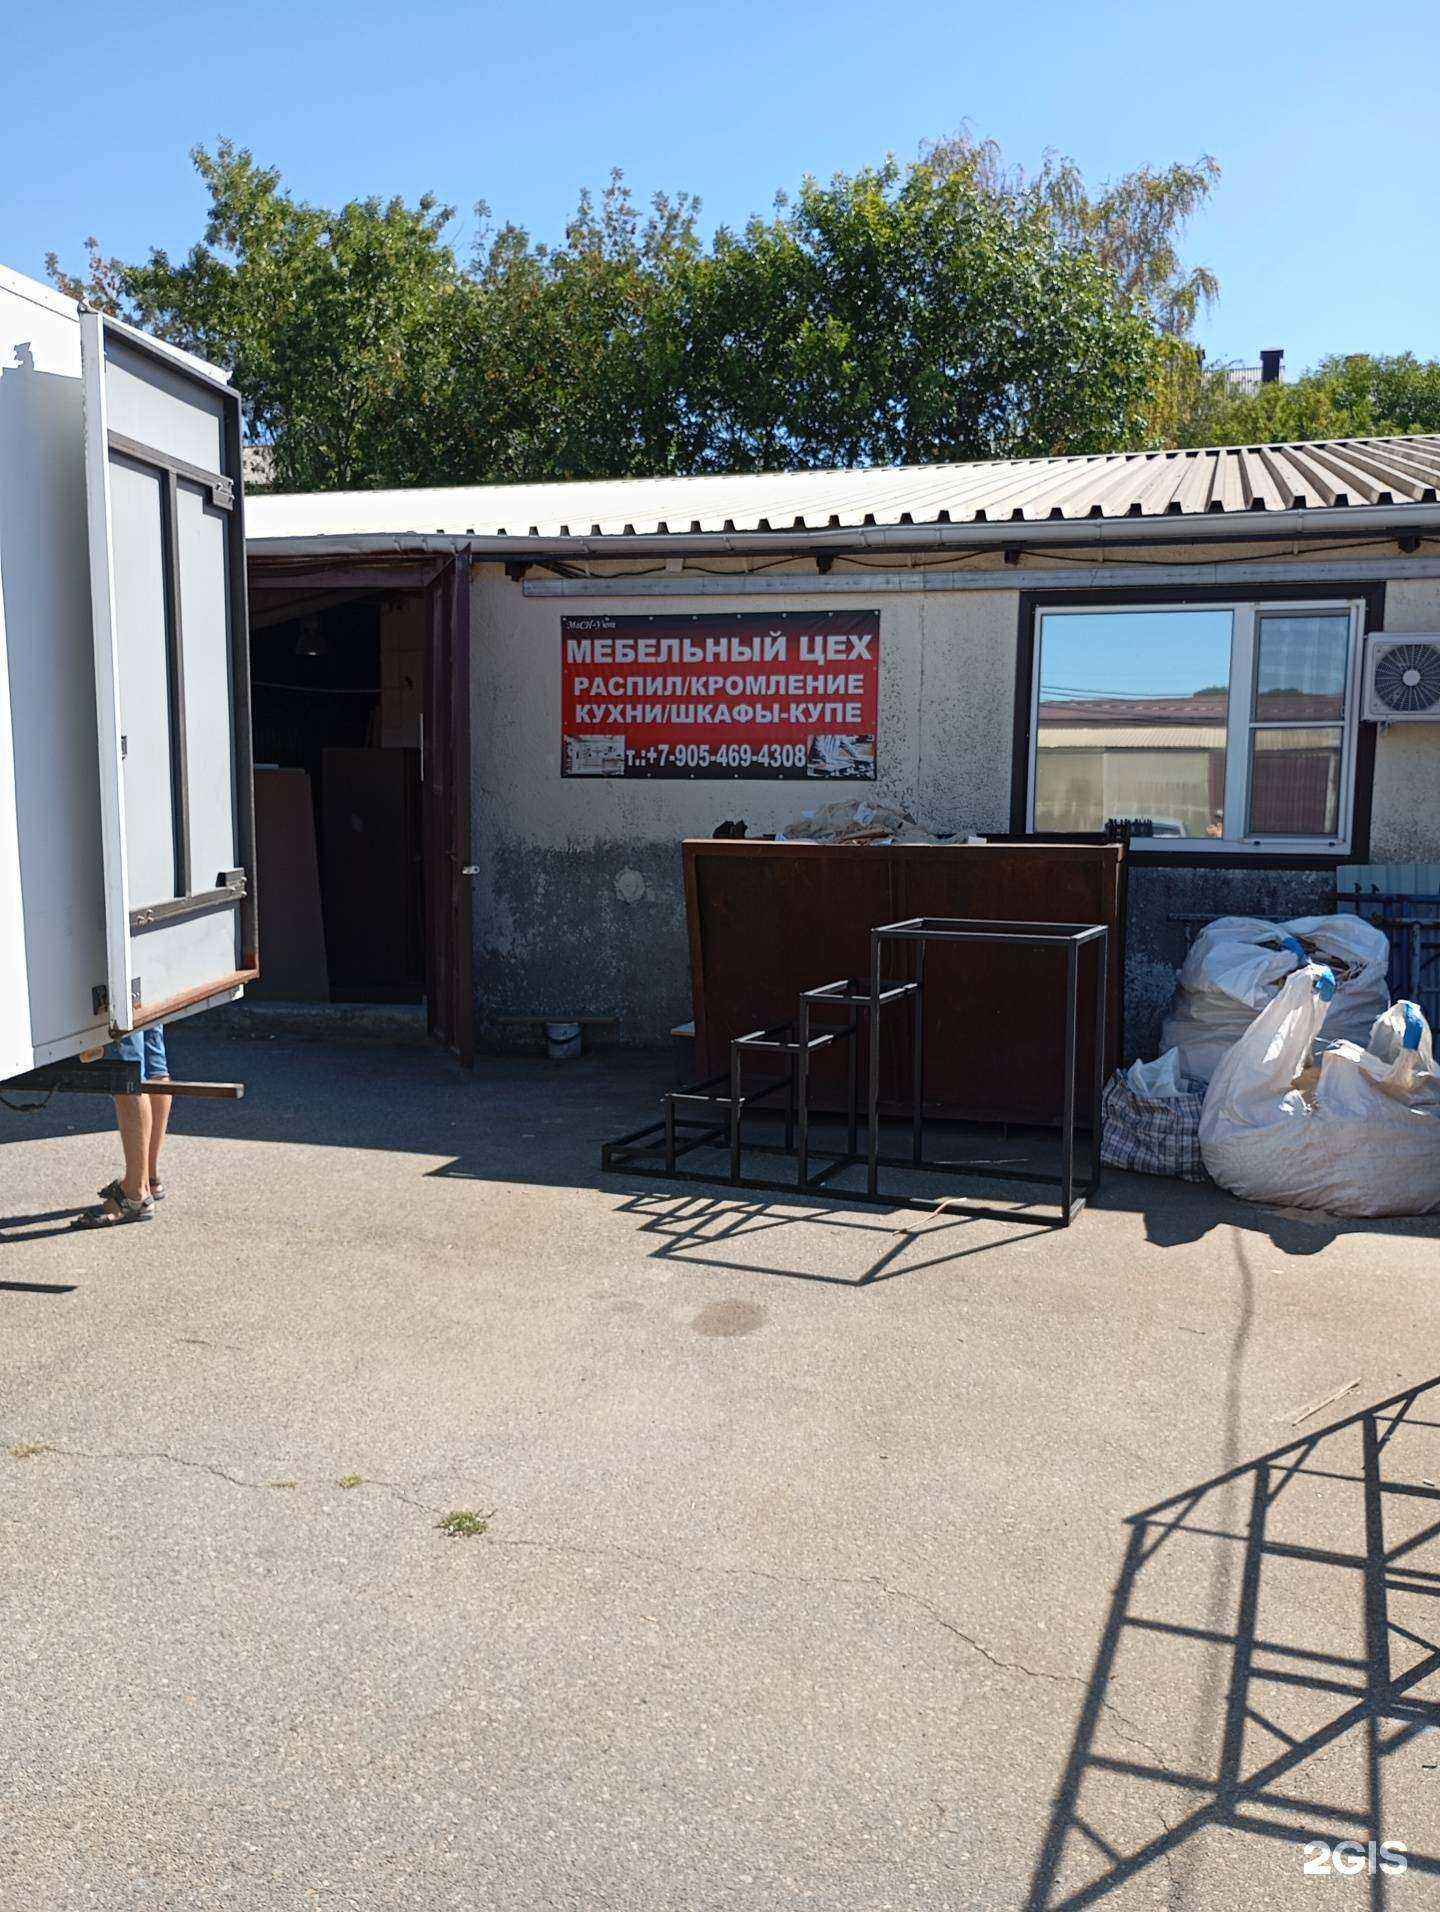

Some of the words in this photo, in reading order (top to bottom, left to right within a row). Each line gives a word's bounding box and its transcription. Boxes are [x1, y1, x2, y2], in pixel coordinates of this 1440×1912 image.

[567, 631, 787, 664] МЕБЕЛЬНЫЙ
[799, 635, 872, 665] ЦЕХ
[574, 674, 864, 696] РАСПИЛ/КРОМЛЕНИЕ
[576, 702, 862, 724] КУХНИ/ШКАФЫ-КУПЕ
